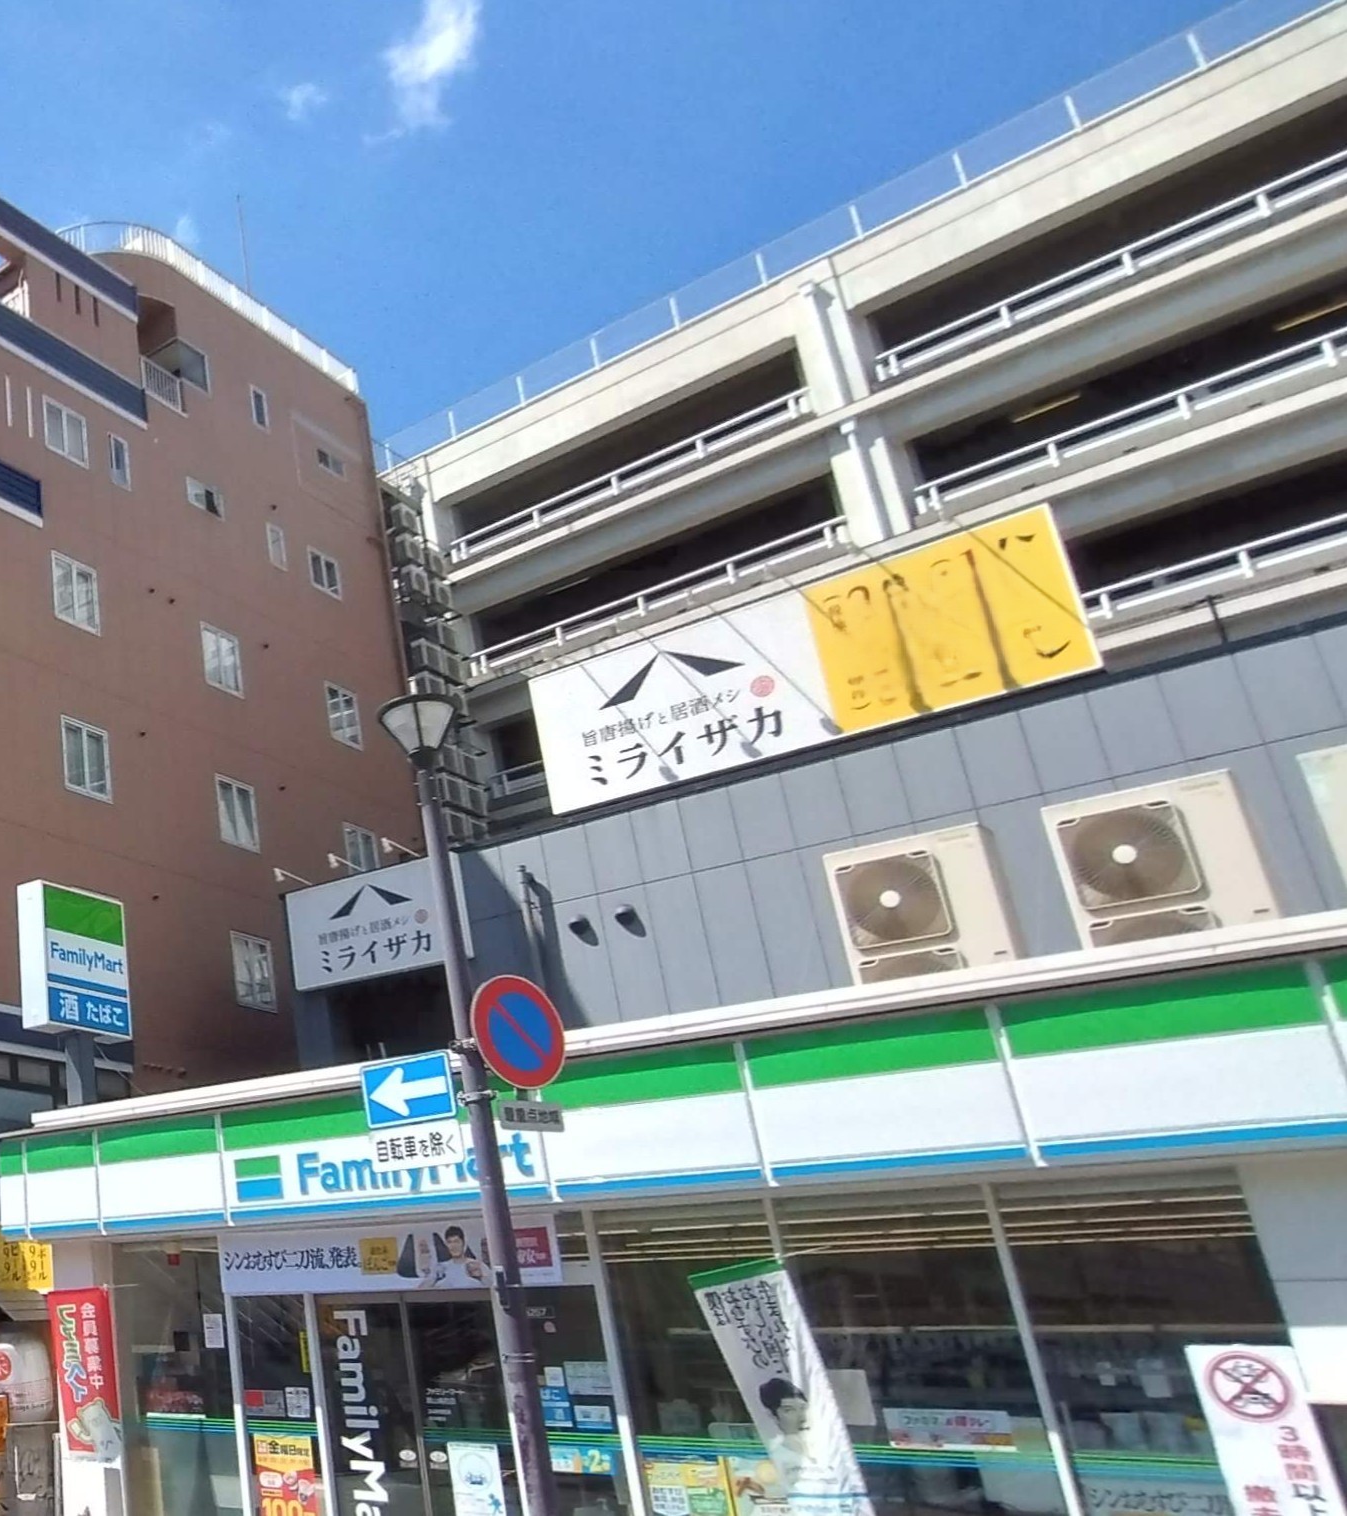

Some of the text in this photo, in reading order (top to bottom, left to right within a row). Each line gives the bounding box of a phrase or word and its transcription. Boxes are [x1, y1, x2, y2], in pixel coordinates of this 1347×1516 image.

[588, 706, 782, 785] ミライザカ
[50, 941, 124, 975] FamilyMart
[321, 930, 432, 973] ミライザカ
[59, 992, 125, 1027] 酒 たばこ
[376, 1132, 457, 1162] 自転車を除く
